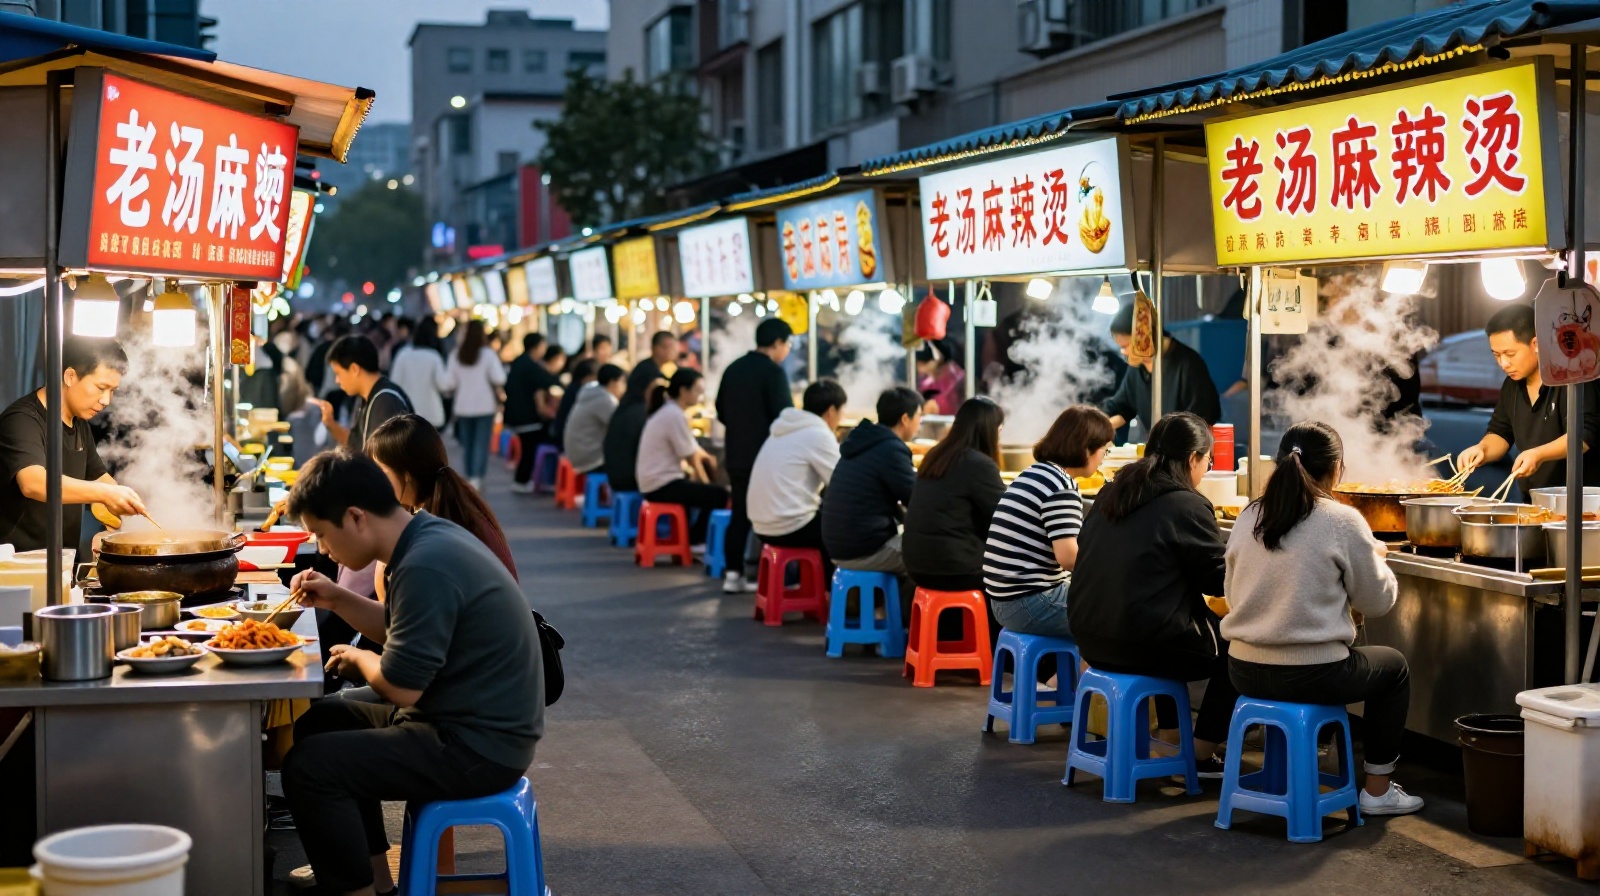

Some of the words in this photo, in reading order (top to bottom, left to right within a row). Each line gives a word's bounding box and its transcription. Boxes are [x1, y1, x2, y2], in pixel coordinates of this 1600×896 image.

[1221, 93, 1527, 221] 老汤麻辣烫
[929, 168, 1069, 258] 老汤麻辣烫
